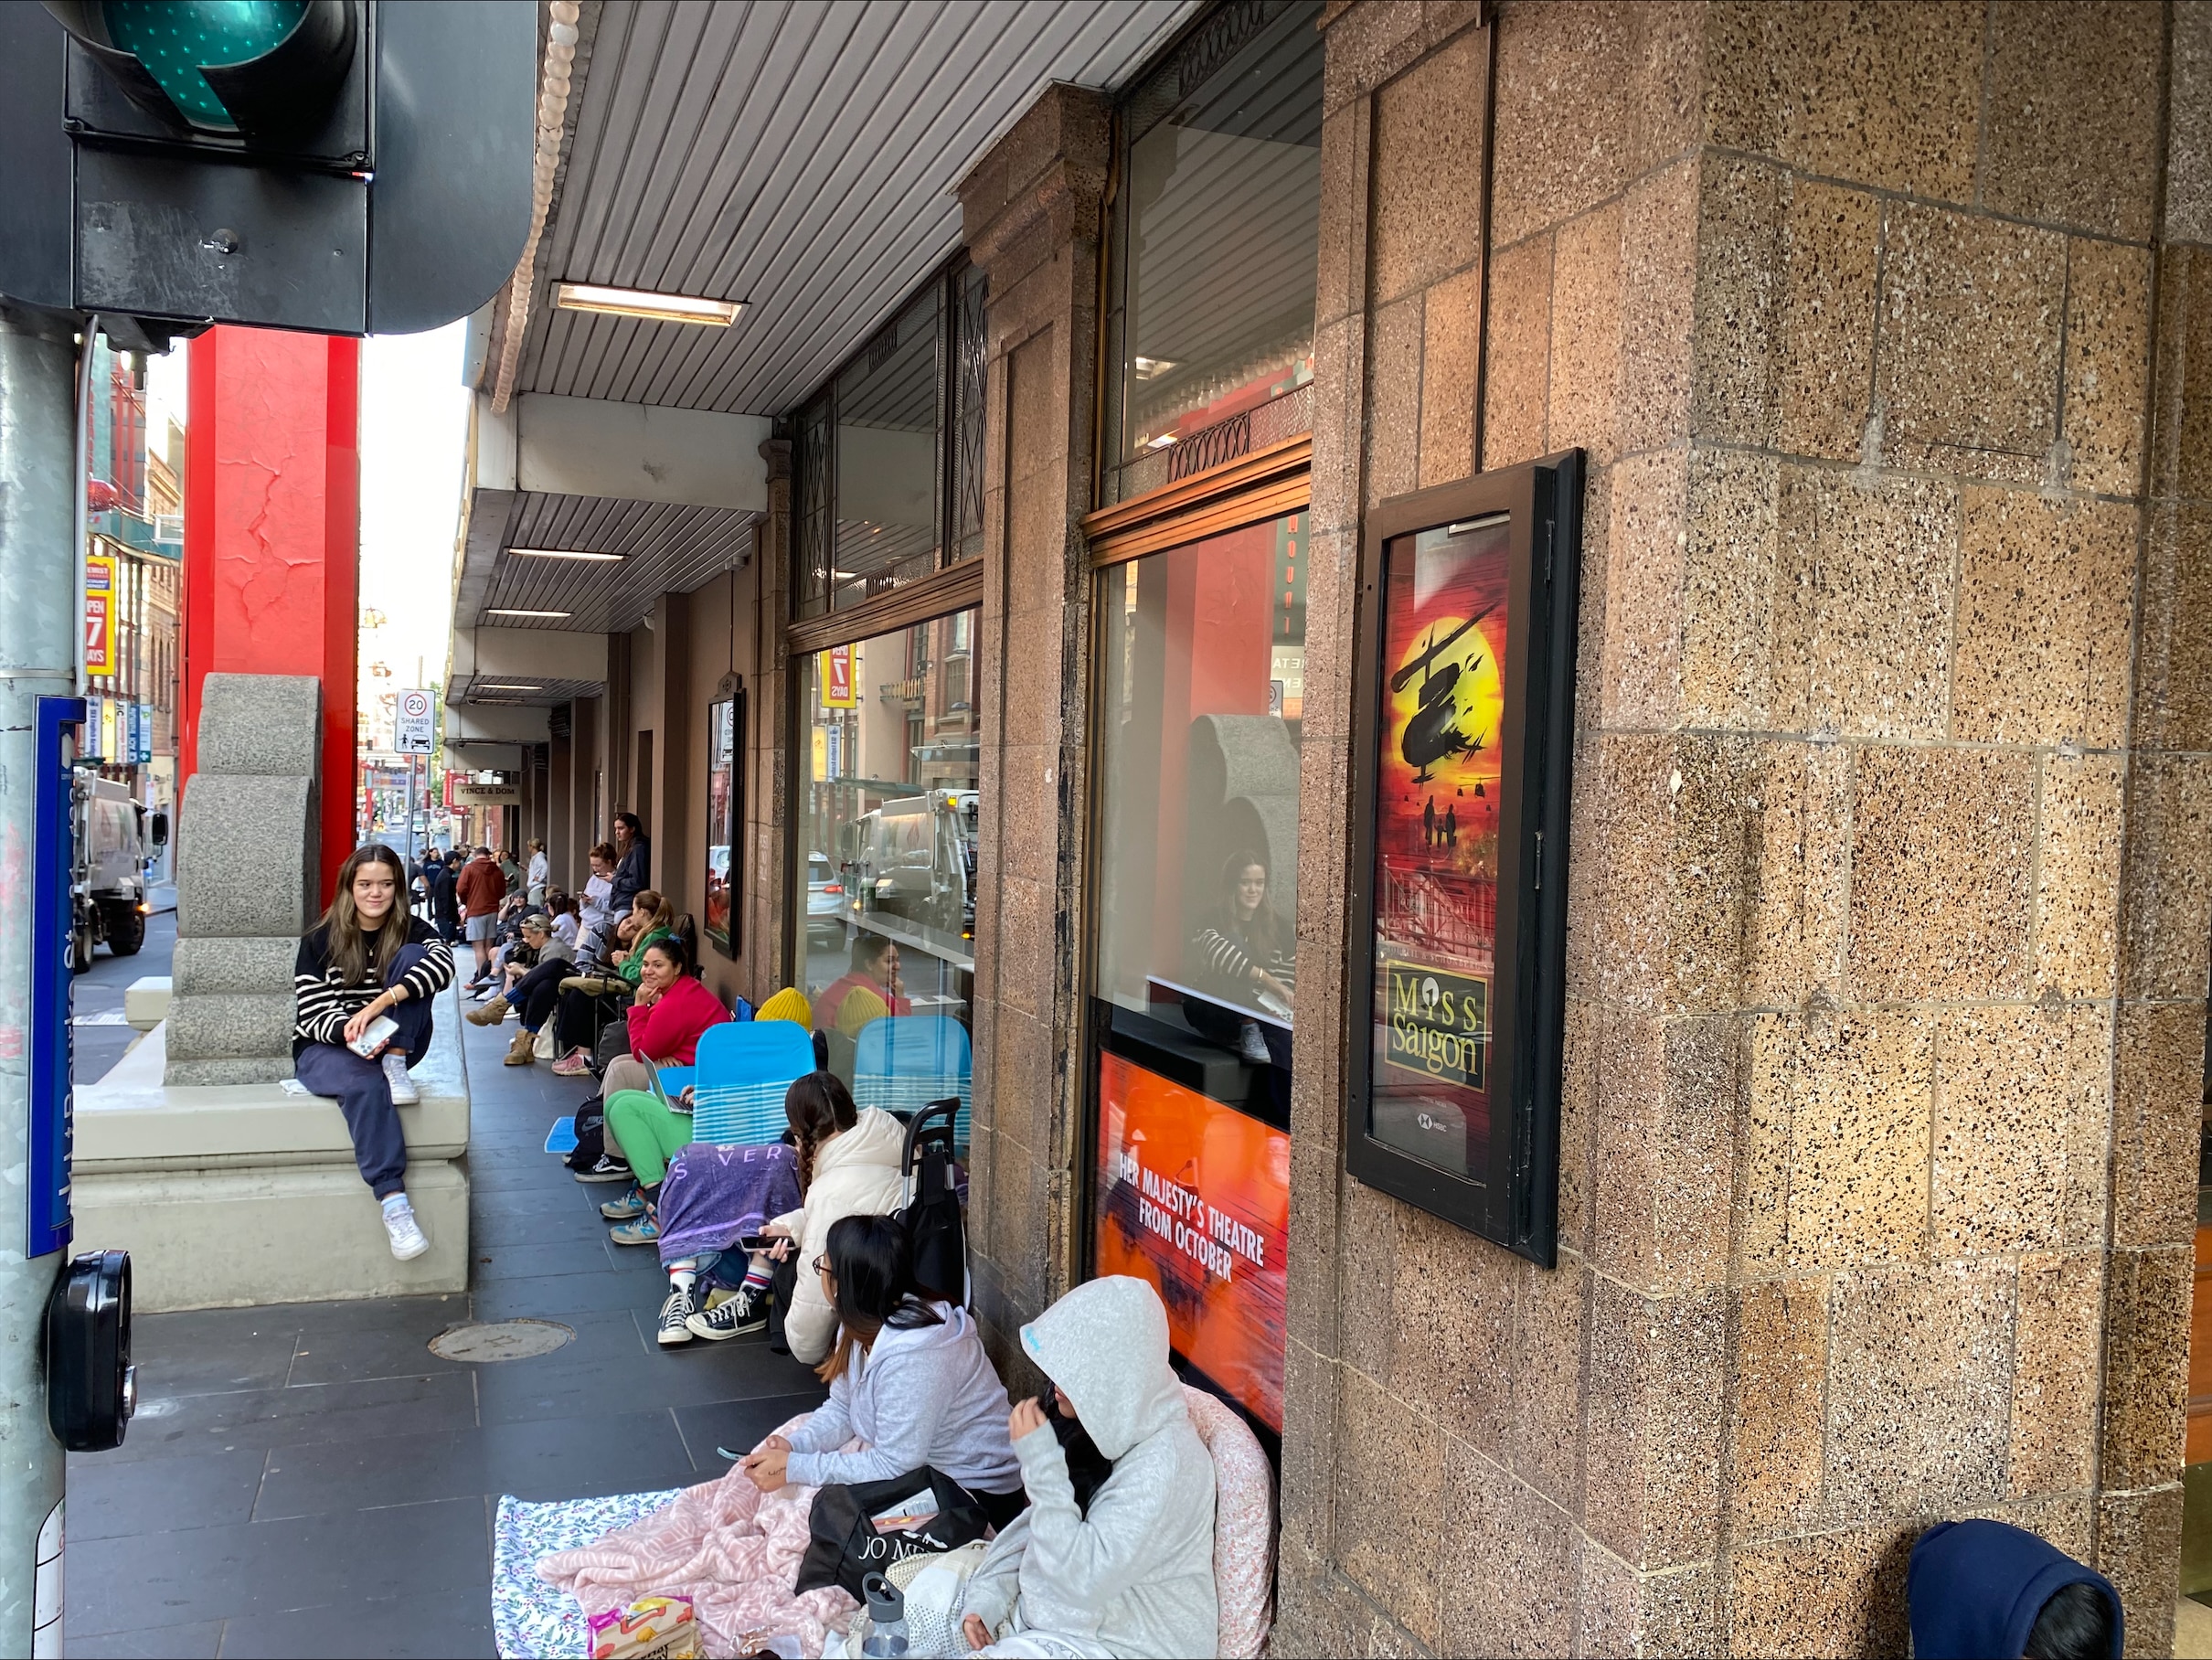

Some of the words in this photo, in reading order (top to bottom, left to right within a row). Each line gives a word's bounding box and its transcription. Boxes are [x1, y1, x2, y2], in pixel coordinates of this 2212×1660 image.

[409, 699, 423, 710] 20
[1392, 1012, 1478, 1075] Saigon
[1120, 1152, 1140, 1188] HER
[1142, 1166, 1204, 1229] MAJESTY'S
[1207, 1205, 1264, 1267] THEATRE
[1139, 1197, 1172, 1242] FROM
[1175, 1220, 1232, 1282] OCTOBER
[858, 1536, 887, 1560] JO
